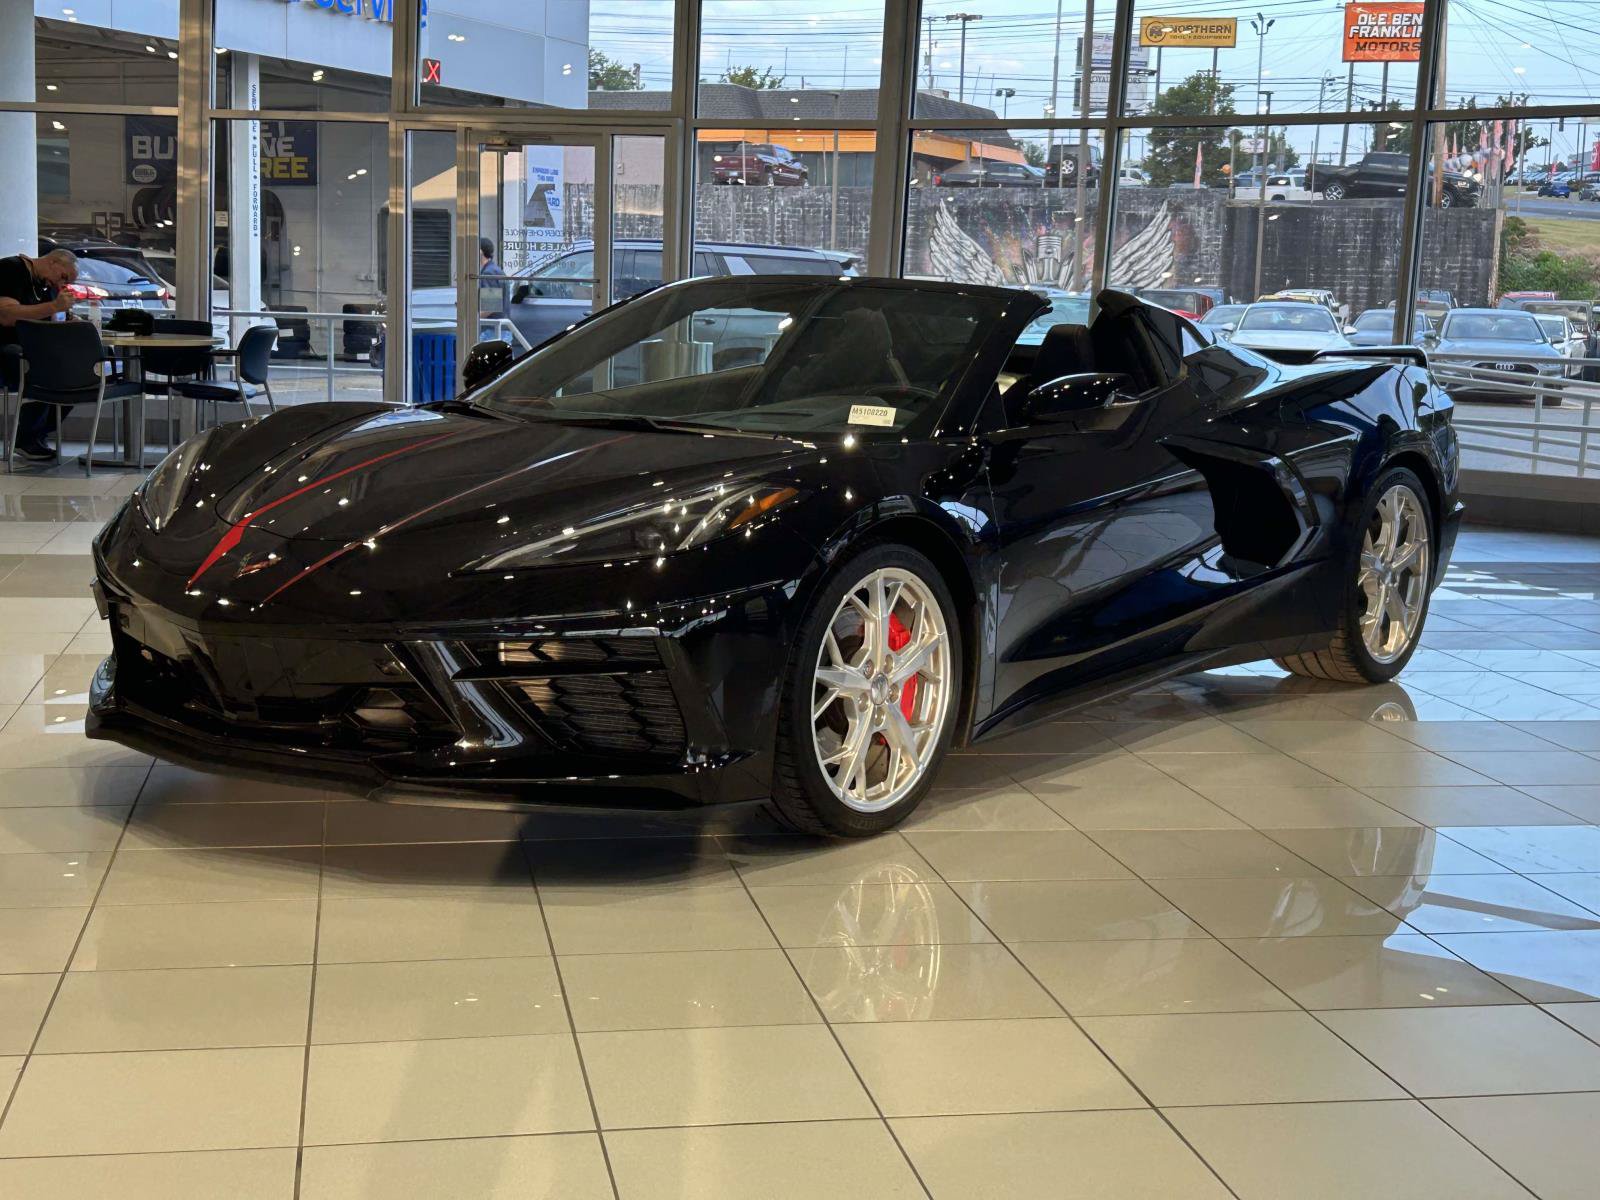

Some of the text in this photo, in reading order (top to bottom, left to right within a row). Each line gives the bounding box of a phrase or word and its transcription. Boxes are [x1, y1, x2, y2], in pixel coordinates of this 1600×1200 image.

[1357, 13, 1424, 26] OLE BEN
[1169, 24, 1232, 34] NORTHERN
[1355, 41, 1421, 52] MOTORS
[132, 135, 177, 160] BU
[260, 136, 295, 158] NE
[260, 156, 309, 179] REE
